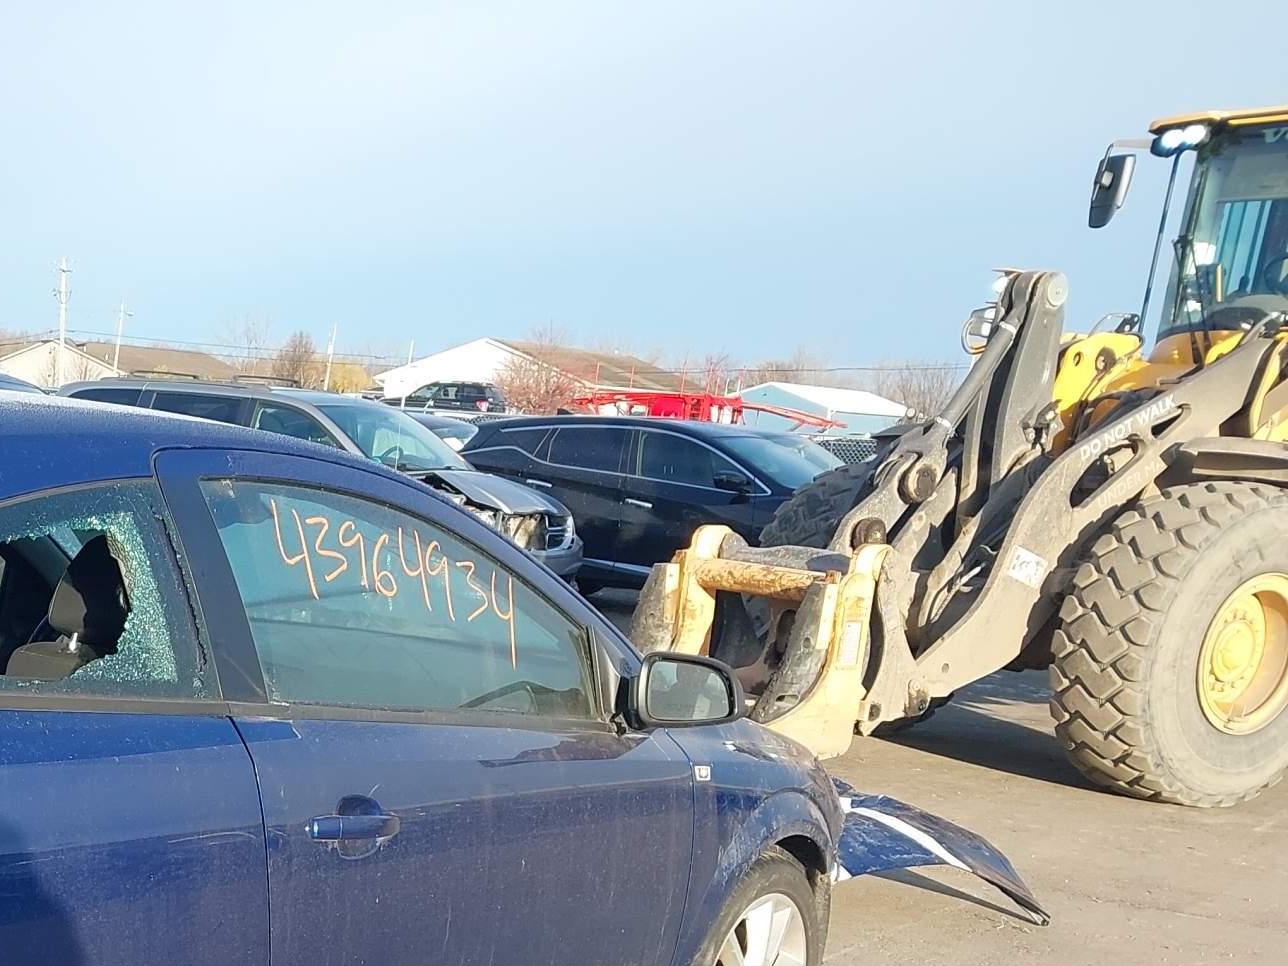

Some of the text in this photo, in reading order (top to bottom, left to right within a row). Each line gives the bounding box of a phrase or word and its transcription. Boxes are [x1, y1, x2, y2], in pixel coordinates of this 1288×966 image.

[1080, 393, 1176, 460] DO NOT WALK
[1097, 471, 1142, 507] UNDER
[269, 498, 518, 671] 43964934
